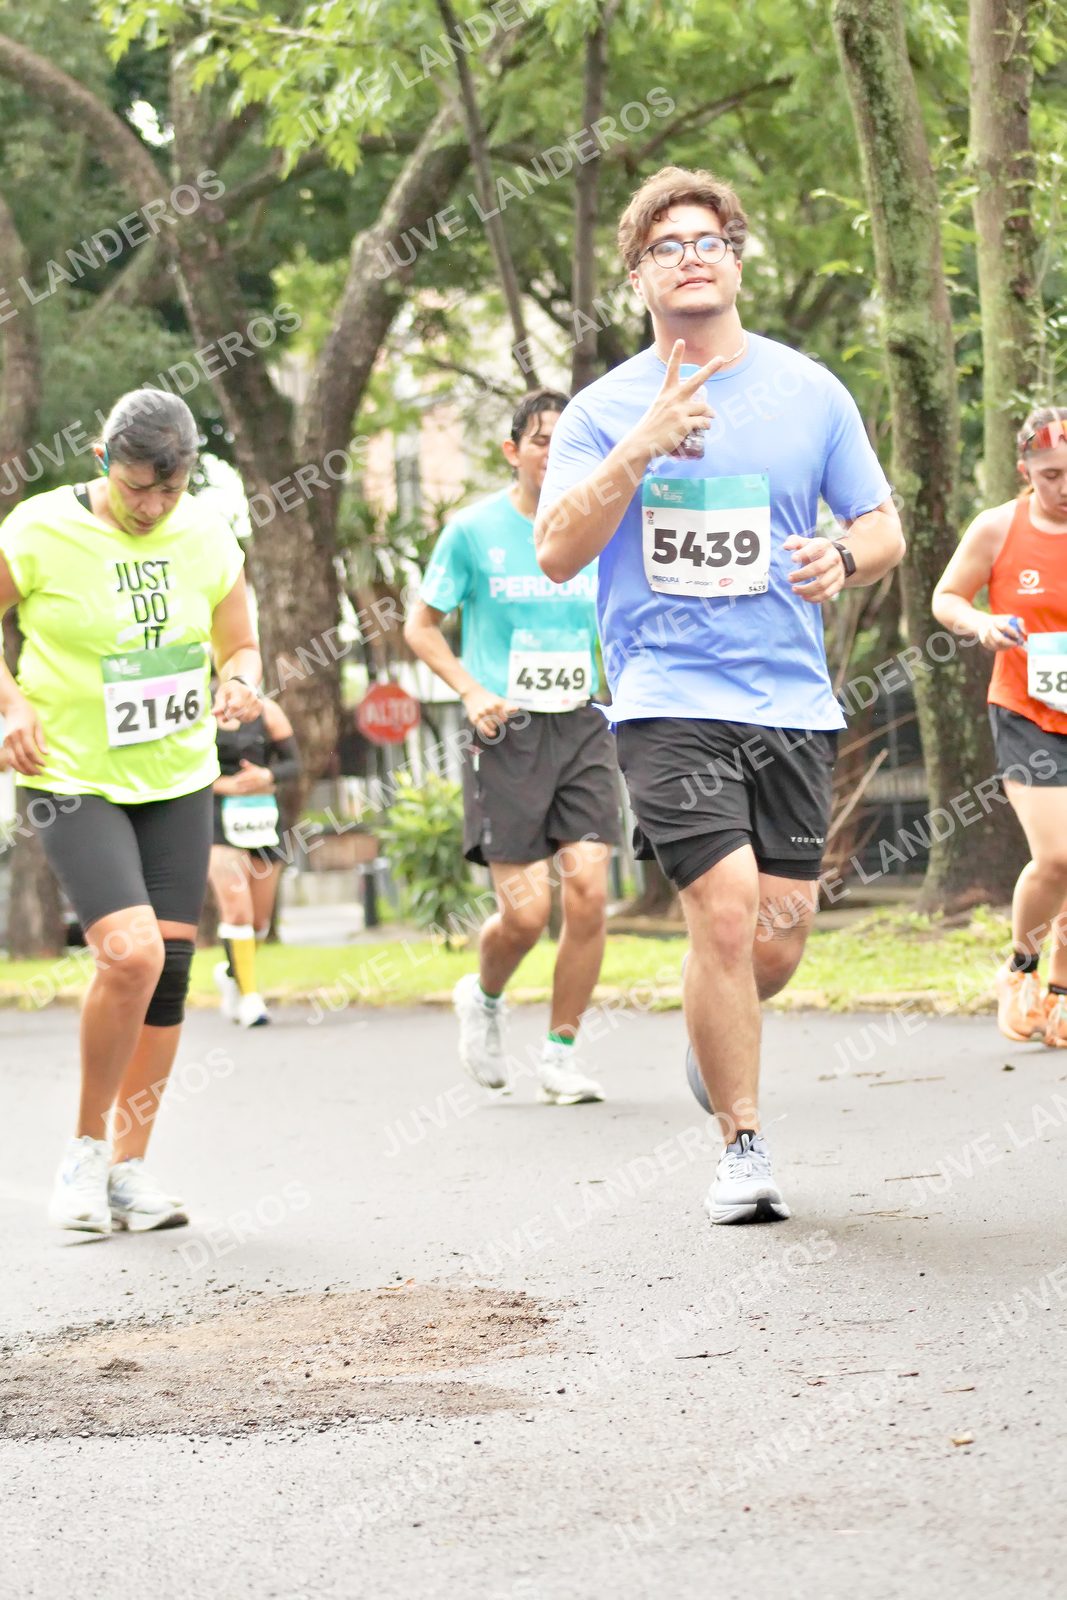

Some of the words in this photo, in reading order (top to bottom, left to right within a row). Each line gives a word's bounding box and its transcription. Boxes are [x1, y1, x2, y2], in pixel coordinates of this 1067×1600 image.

[651, 528, 760, 568] 5439
[115, 560, 171, 592] JUST
[131, 592, 170, 624] DO
[143, 625, 165, 650] IT
[516, 667, 586, 691] 4349
[114, 689, 200, 733] 2146
[364, 698, 417, 725] ALTO
